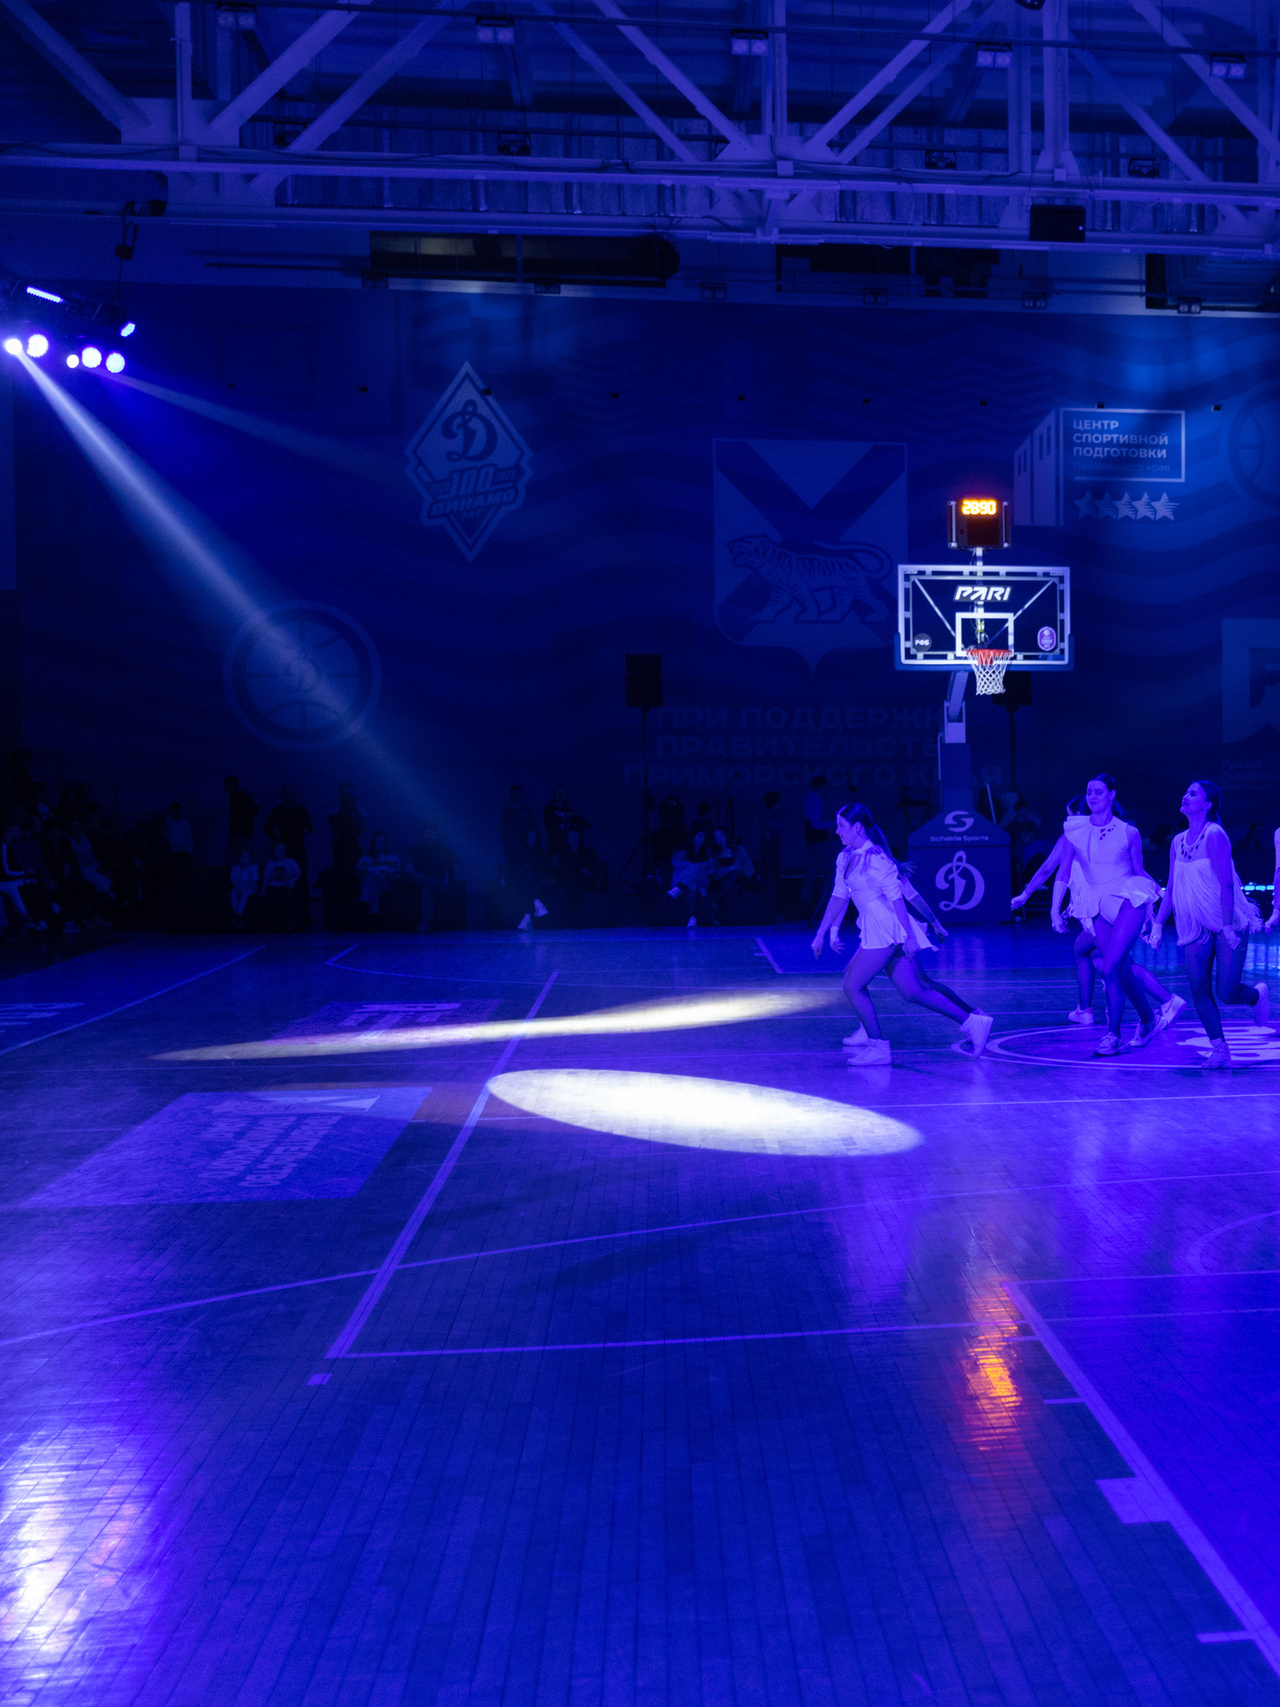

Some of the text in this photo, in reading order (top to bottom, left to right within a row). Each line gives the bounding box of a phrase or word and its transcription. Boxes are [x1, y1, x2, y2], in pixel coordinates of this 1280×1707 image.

[1073, 419, 1119, 431] ЦЕНТР
[1073, 432, 1169, 445] СПОРТИВНОЙ
[1073, 446, 1167, 459] ПОДГОТОВКИ
[1146, 463, 1171, 473] края
[450, 465, 496, 499] 100
[430, 488, 516, 516] ДИНАМО
[954, 586, 1011, 601] PARI
[657, 706, 944, 733] ПРИ ПОДДЕРЖК
[657, 735, 939, 759] ПРАВИТЕЛЬСТВ
[623, 764, 897, 788] ПРИМОРСКОГО
[963, 835, 989, 843] Sports
